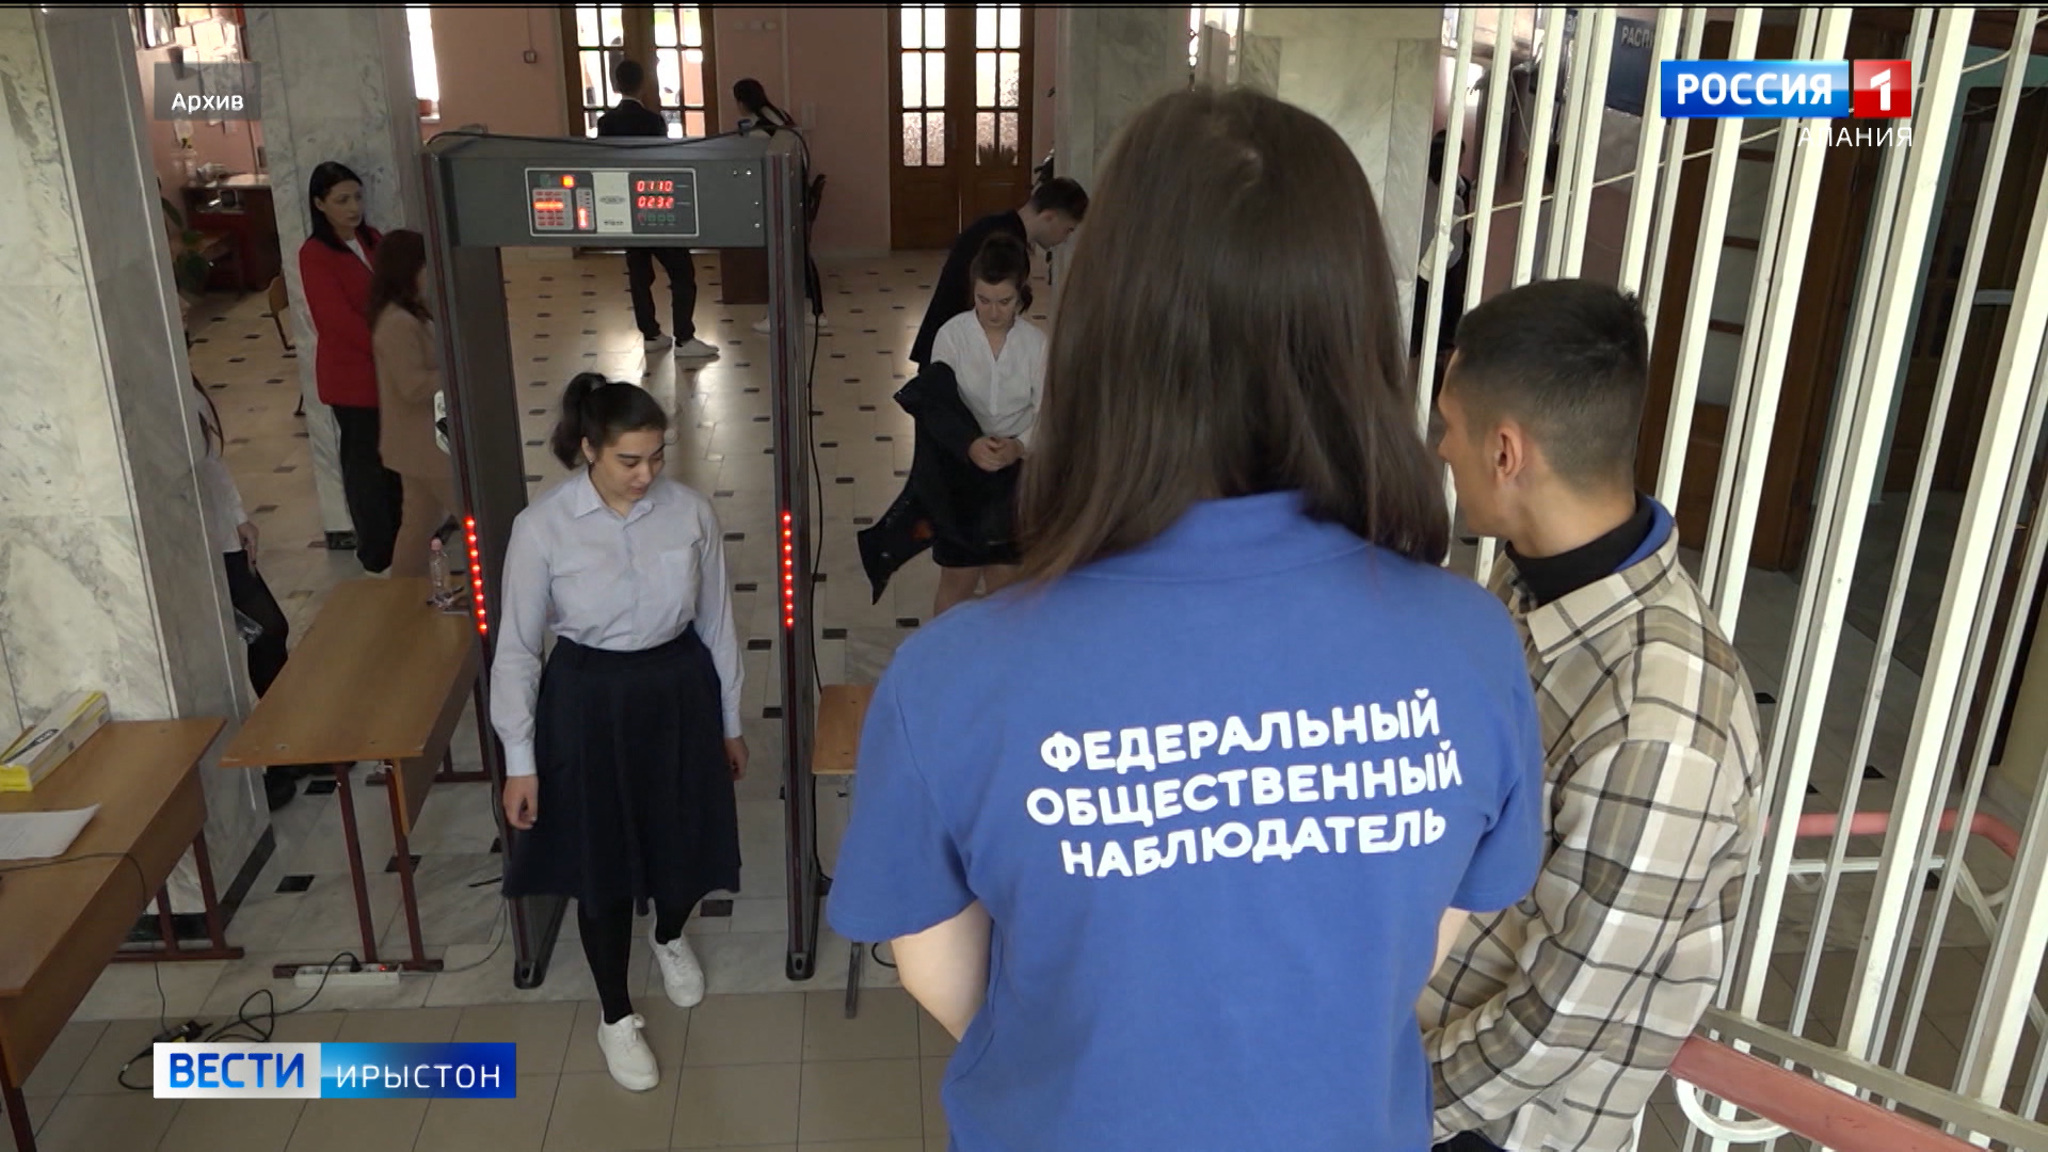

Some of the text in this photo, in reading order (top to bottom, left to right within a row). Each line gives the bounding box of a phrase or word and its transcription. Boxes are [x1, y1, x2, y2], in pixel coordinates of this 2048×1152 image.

[1040, 688, 1440, 774] ФЕДЕРАЛЬНЫЙ
[1026, 740, 1462, 827] ОБЩЕСТВЕННЫЙ
[1061, 808, 1446, 878] НАБЛЮДАТЕЛЬ
